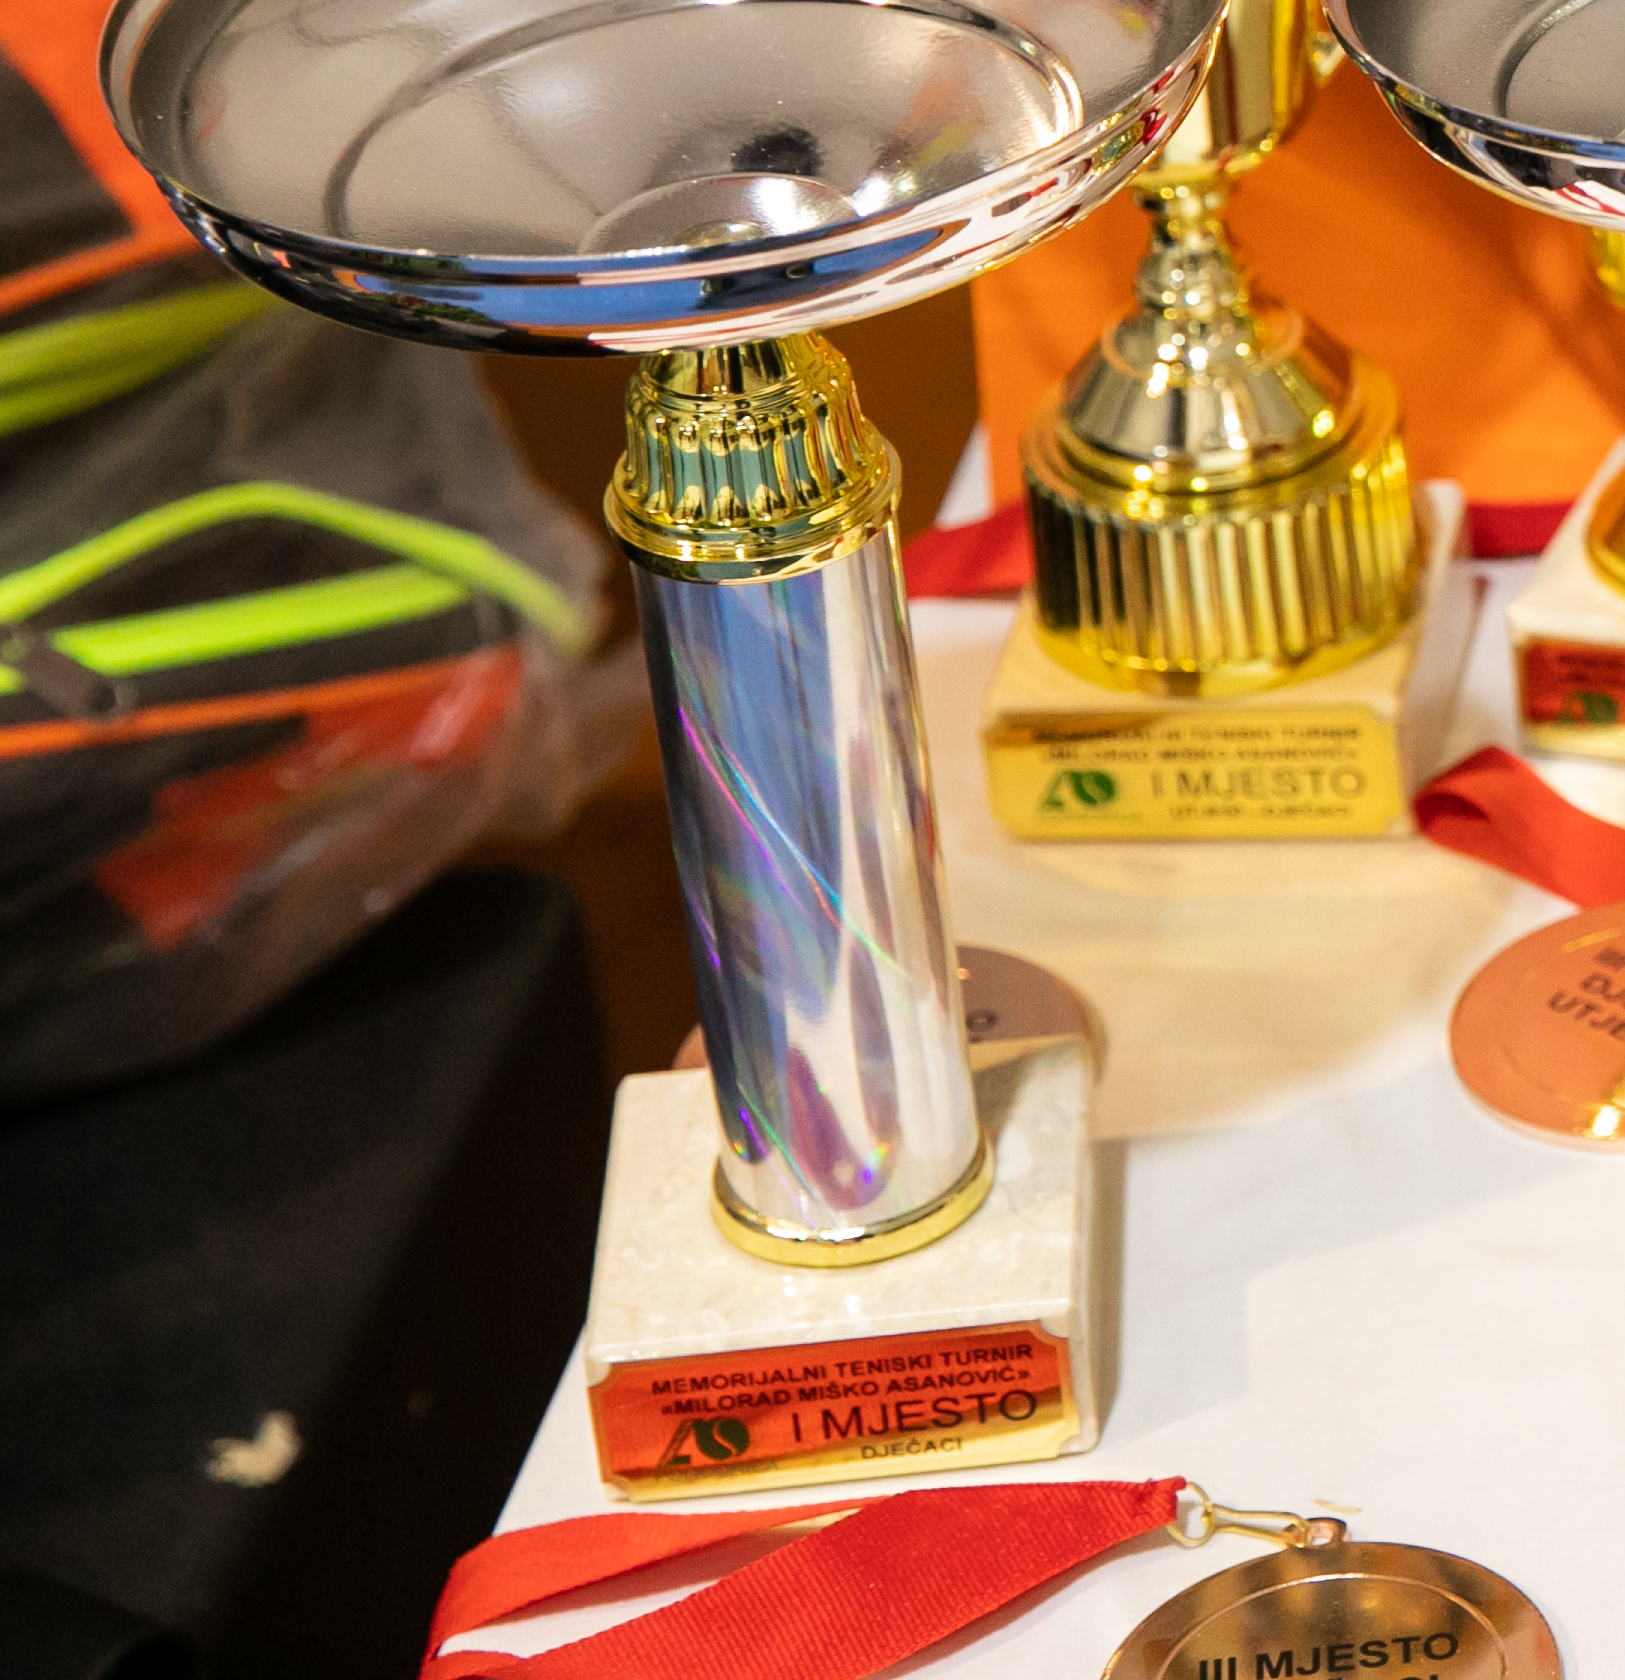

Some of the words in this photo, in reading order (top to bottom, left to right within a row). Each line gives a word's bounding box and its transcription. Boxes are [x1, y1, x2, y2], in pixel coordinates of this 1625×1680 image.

[652, 1364, 827, 1397] MEMORIJALNI
[834, 1352, 932, 1378] TENISKI
[943, 1342, 1033, 1367] TURNIR
[661, 1388, 790, 1416] «MILORAD
[797, 1378, 878, 1405] MIŠKO
[886, 1364, 1030, 1395] ASANOVIĆ»
[792, 1413, 801, 1443] I
[822, 1390, 1037, 1441] MJESTO
[862, 1436, 962, 1461] DJEČACI
[1200, 1656, 1238, 1680] III
[1255, 1632, 1460, 1680] MJESTO
